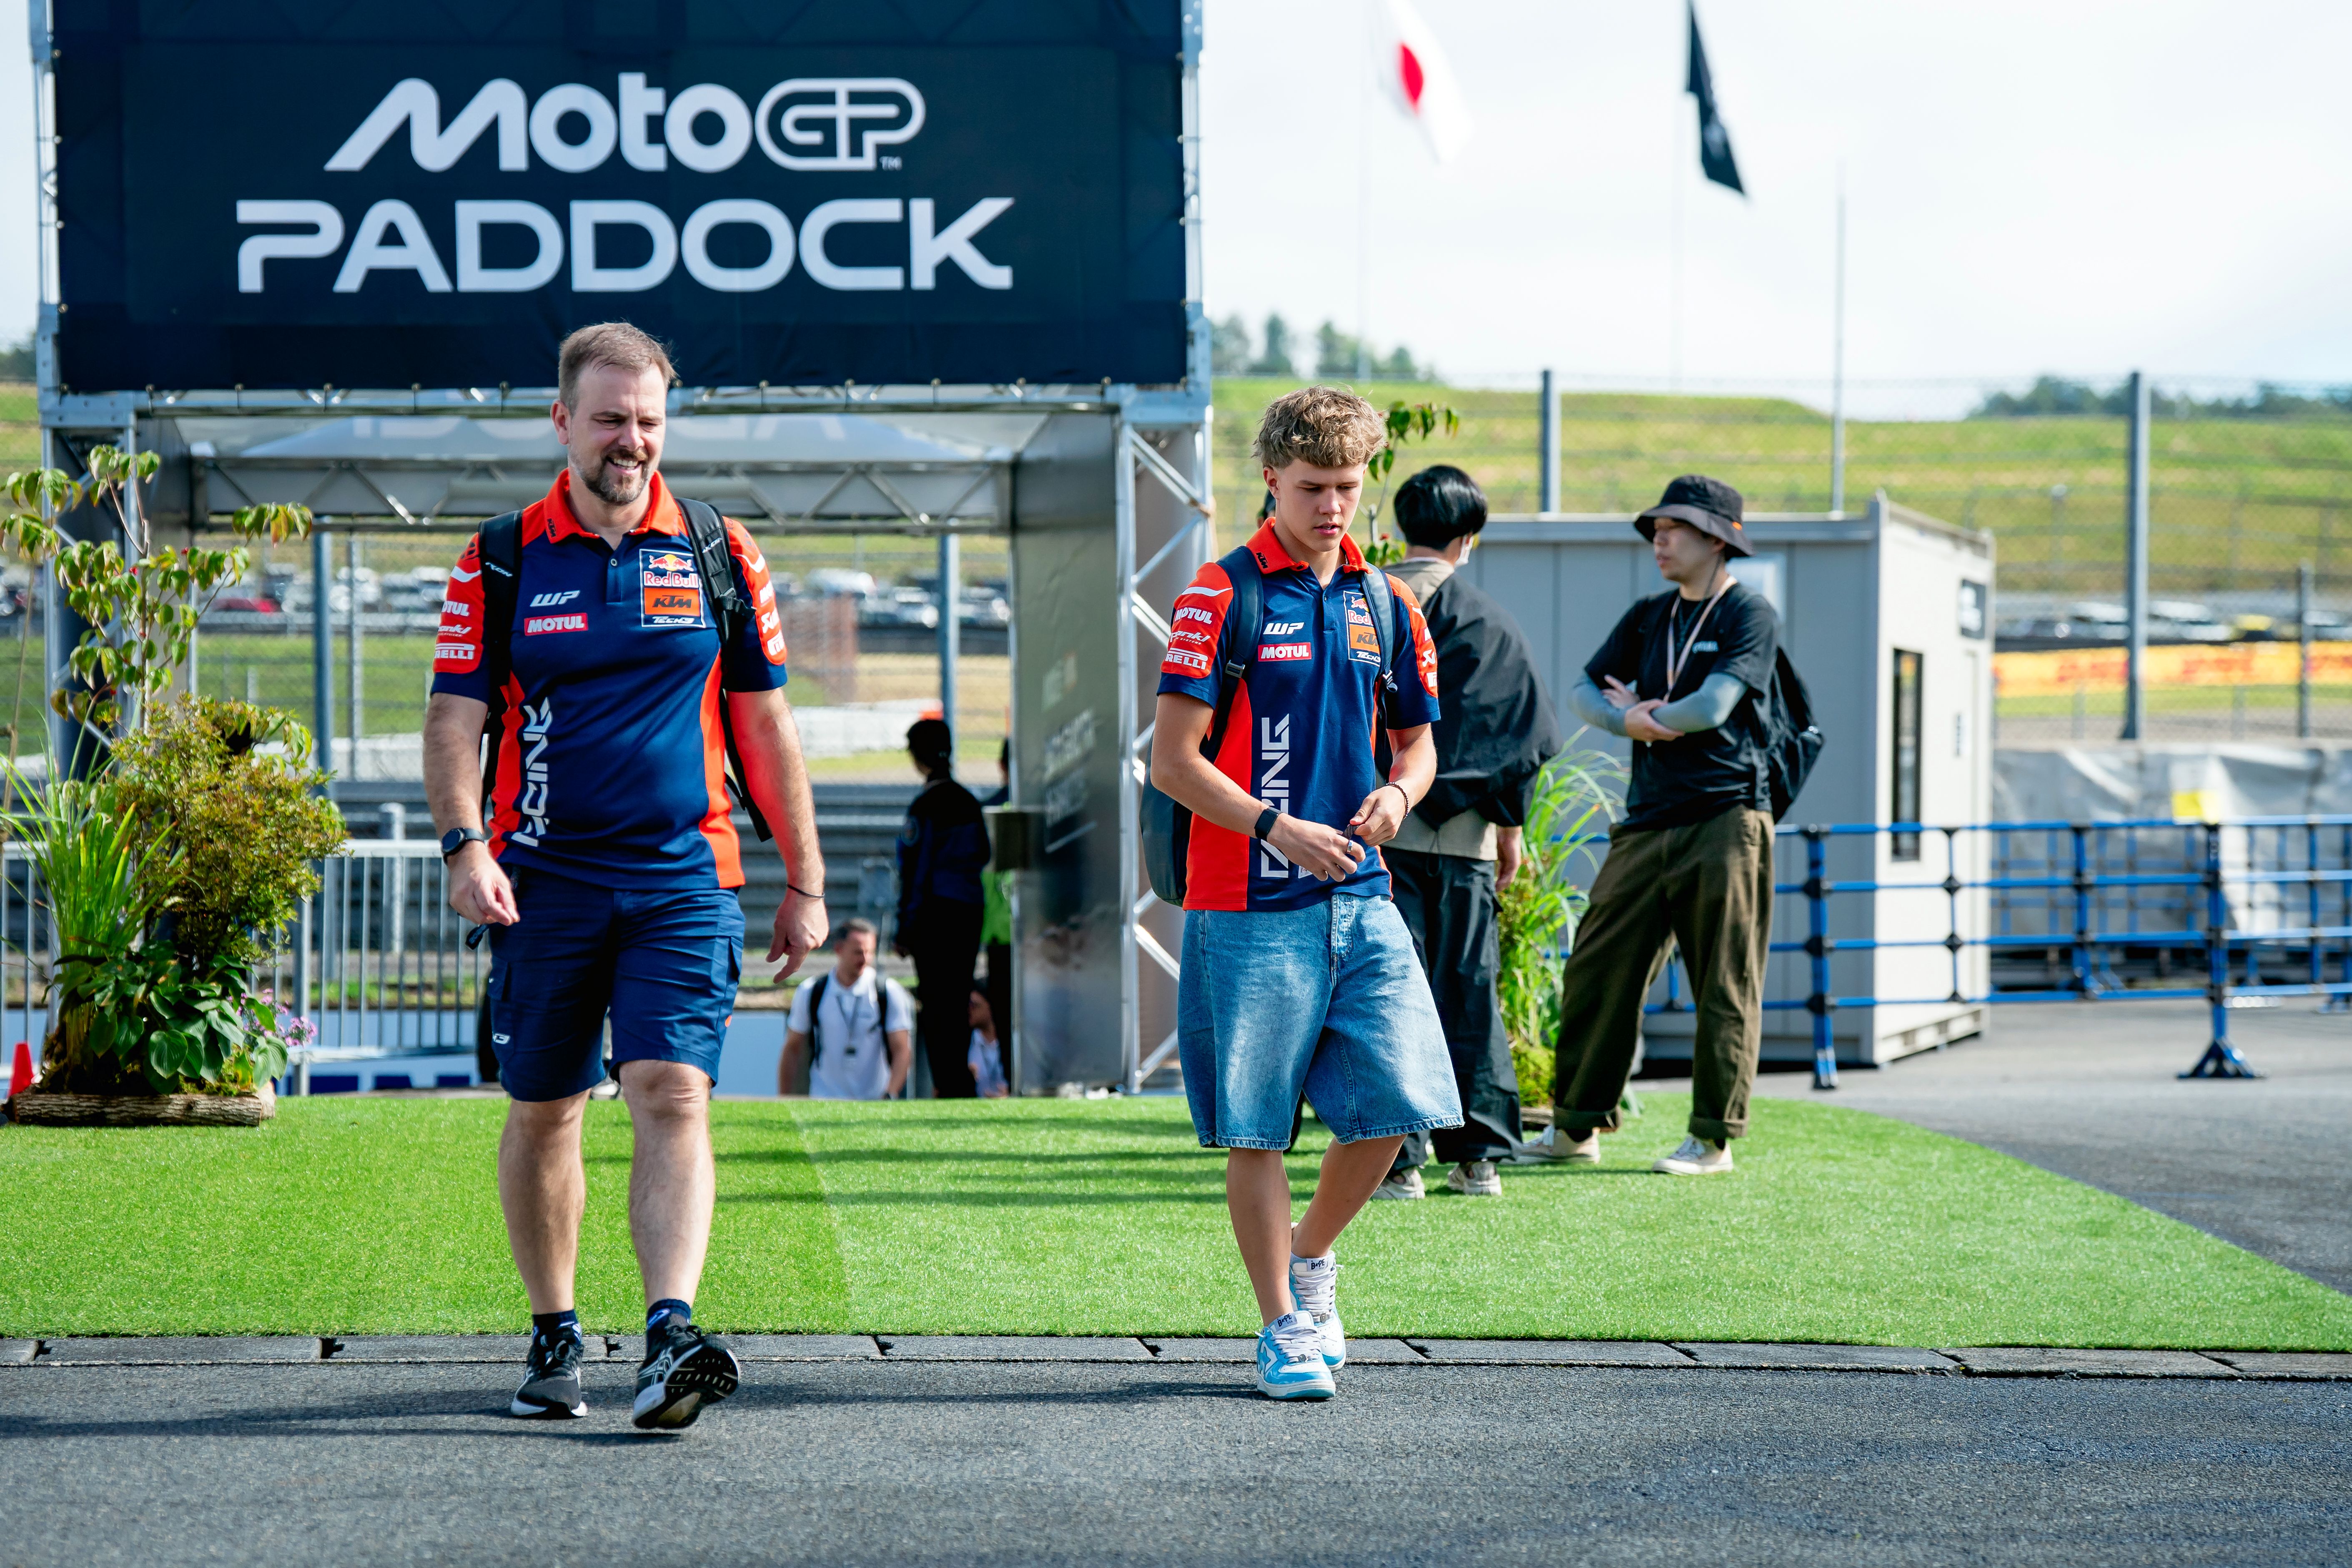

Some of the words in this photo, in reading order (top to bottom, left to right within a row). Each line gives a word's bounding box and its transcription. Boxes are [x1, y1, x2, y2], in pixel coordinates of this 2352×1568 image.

[323, 72, 926, 173] MotoGP
[236, 197, 1014, 293] PADDOCK
[1256, 552, 1269, 569] KTM
[644, 572, 671, 586] Red
[672, 573, 697, 587] Bull
[441, 600, 470, 617] OTUL
[652, 595, 692, 608] KTM
[527, 616, 584, 633] MOTUL
[1175, 607, 1213, 625] MOTUL
[1348, 610, 1370, 625] Red
[1165, 647, 1208, 670] RELLI
[1261, 646, 1309, 659] MOTUL
